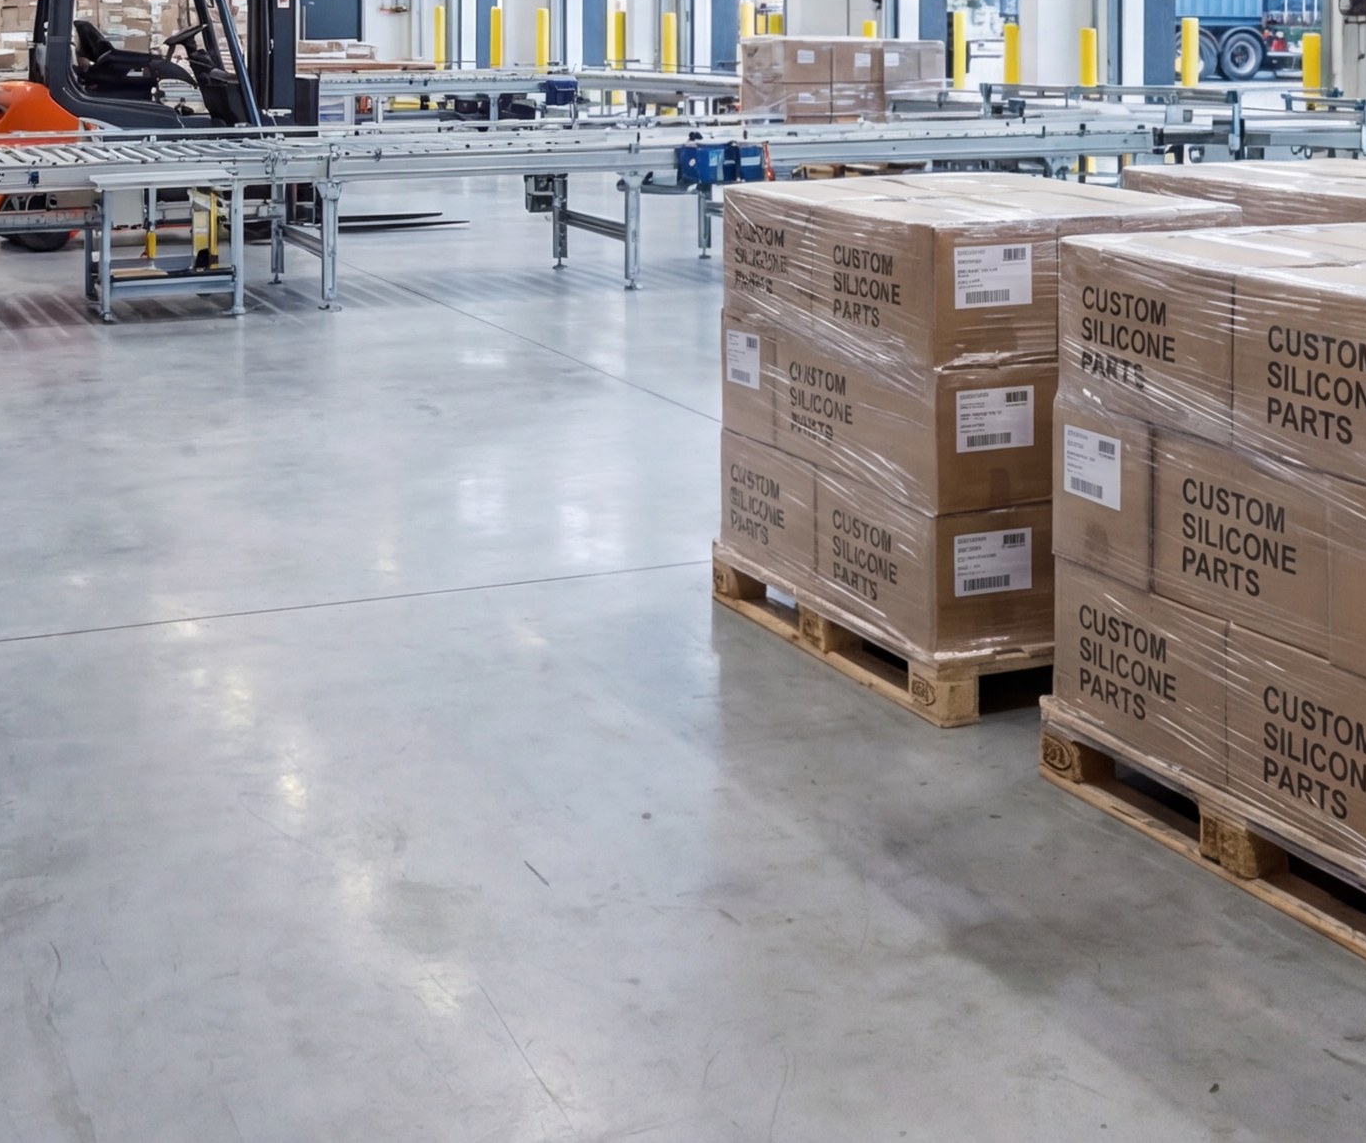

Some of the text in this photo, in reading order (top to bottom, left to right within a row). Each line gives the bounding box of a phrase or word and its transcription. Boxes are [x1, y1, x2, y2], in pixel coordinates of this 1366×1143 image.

[833, 298, 881, 328] PARTS
[1082, 286, 1166, 327] CUSTOM
[1081, 317, 1176, 363] SILICONE
[1267, 397, 1353, 444] PARTS
[1182, 478, 1285, 533] CUSTOM
[832, 535, 898, 585] SILICONE
[1182, 512, 1296, 575] SILICONE
[1182, 546, 1260, 597] PARTS
[1079, 604, 1166, 664] CUSTOM
[1080, 637, 1176, 703] SILICONE
[1080, 667, 1146, 720] PARTS
[1263, 756, 1348, 820] PARTS
